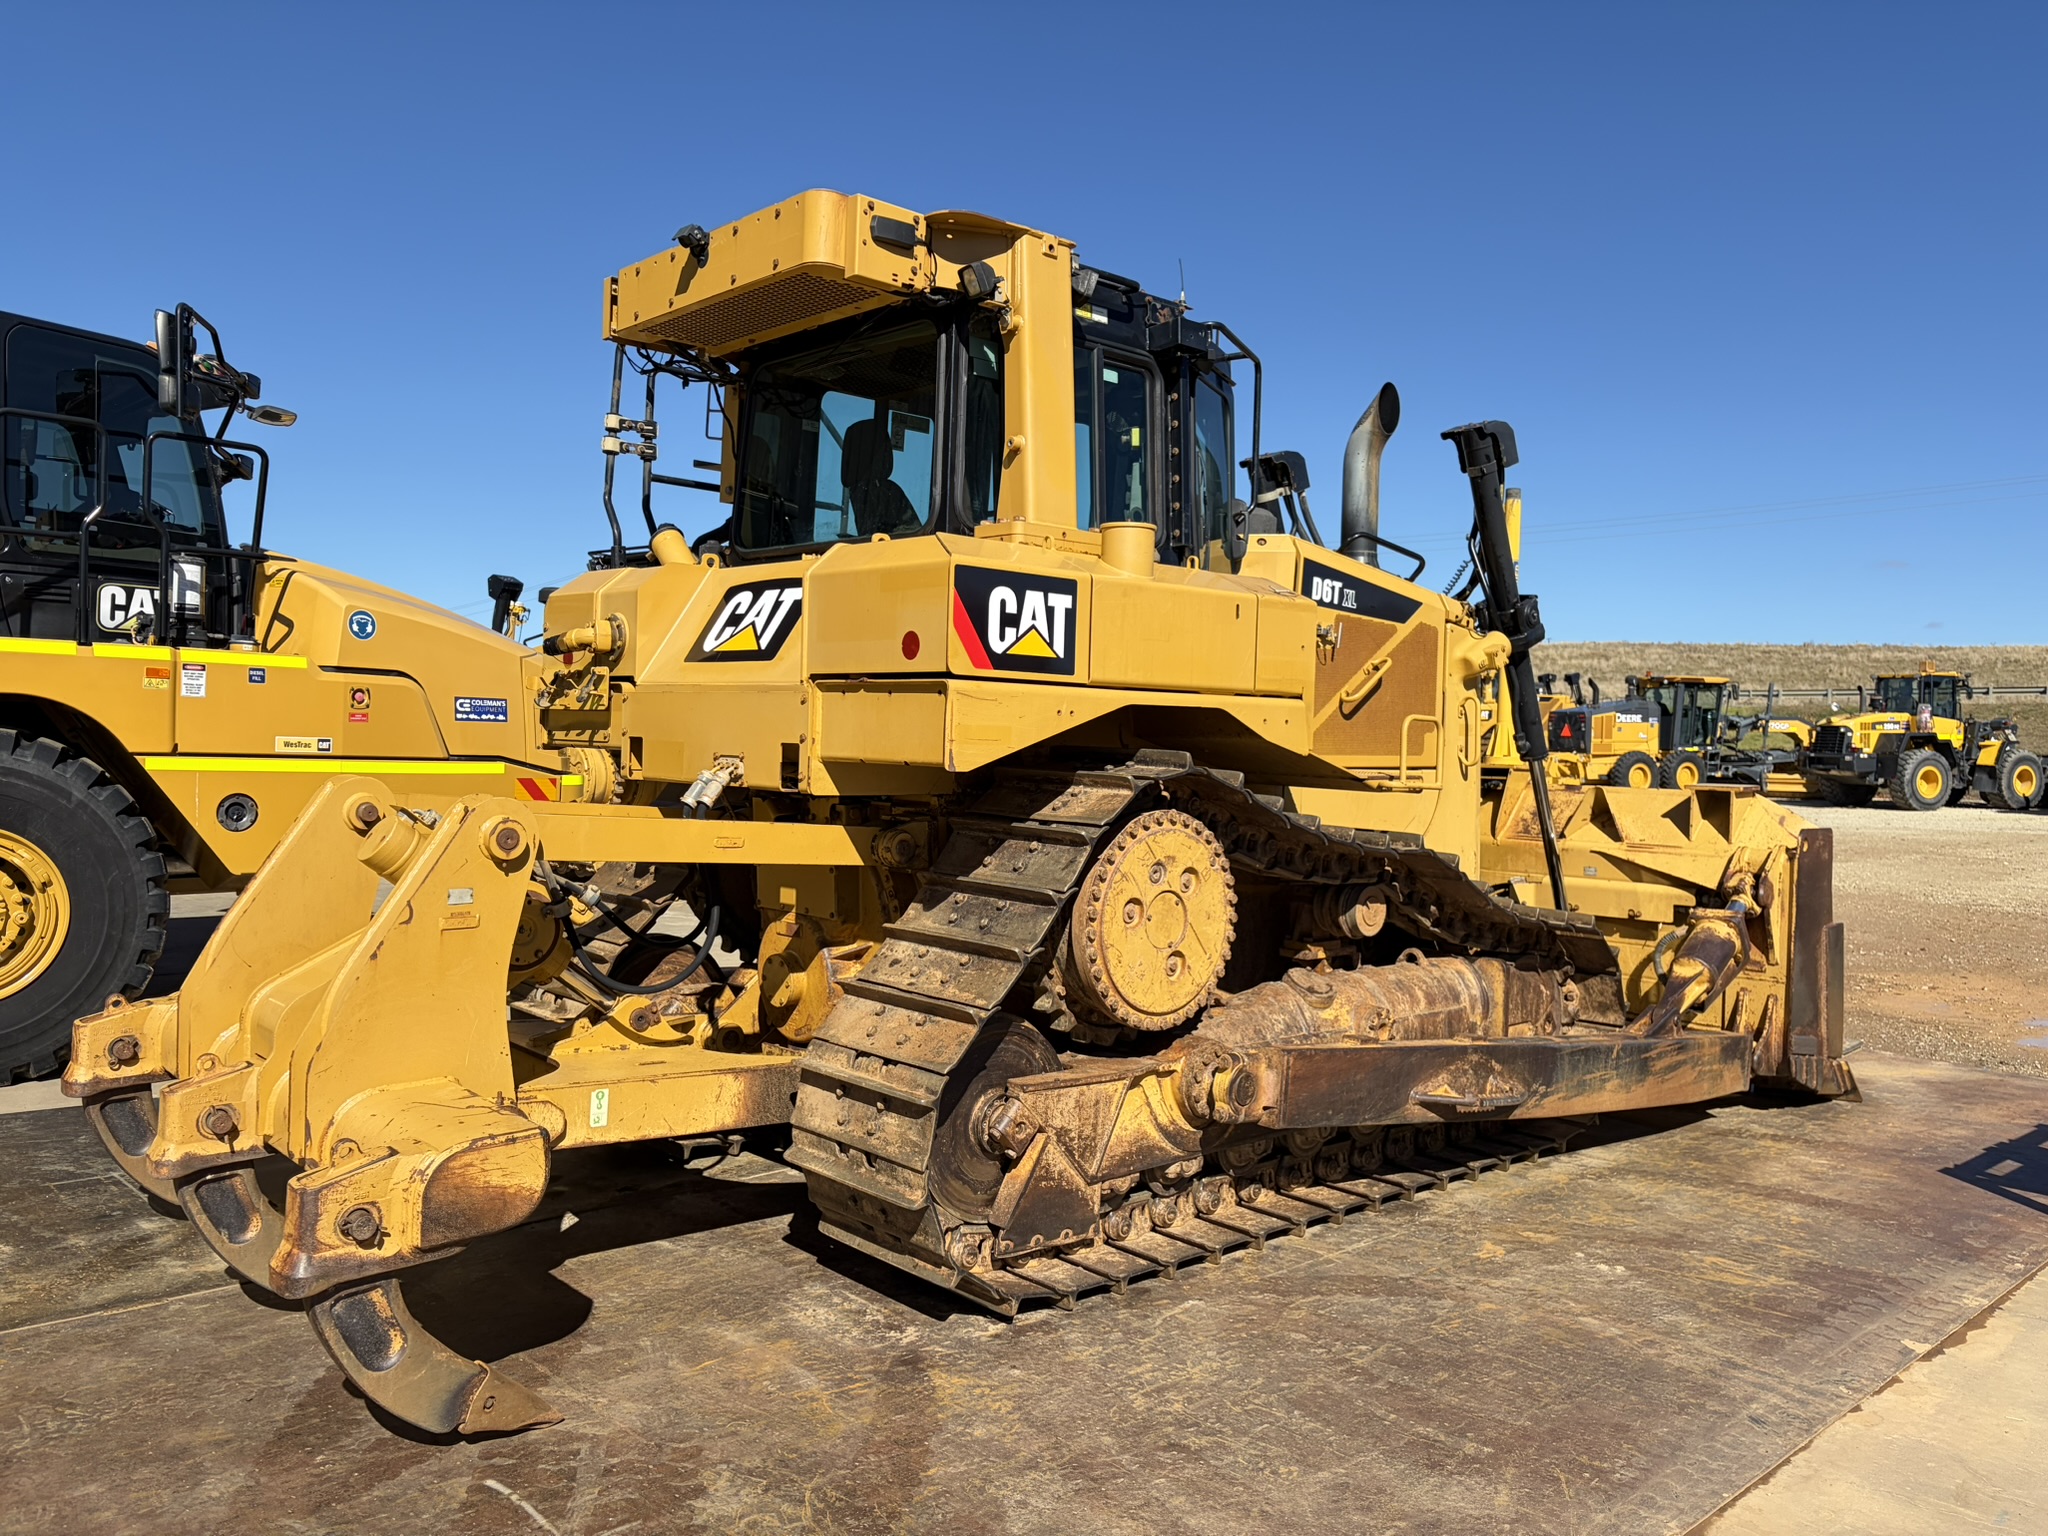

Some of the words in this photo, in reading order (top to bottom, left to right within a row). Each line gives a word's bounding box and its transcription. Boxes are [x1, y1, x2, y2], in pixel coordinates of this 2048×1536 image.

[1312, 576, 1343, 605] D6T
[1342, 588, 1357, 609] XL
[702, 587, 803, 652] CAT
[988, 585, 1073, 659] CAT
[471, 699, 506, 707] COLEMAN'S
[1616, 713, 1643, 723] DEERE
[283, 740, 312, 749] WesTrac
[318, 741, 331, 749] CAT
